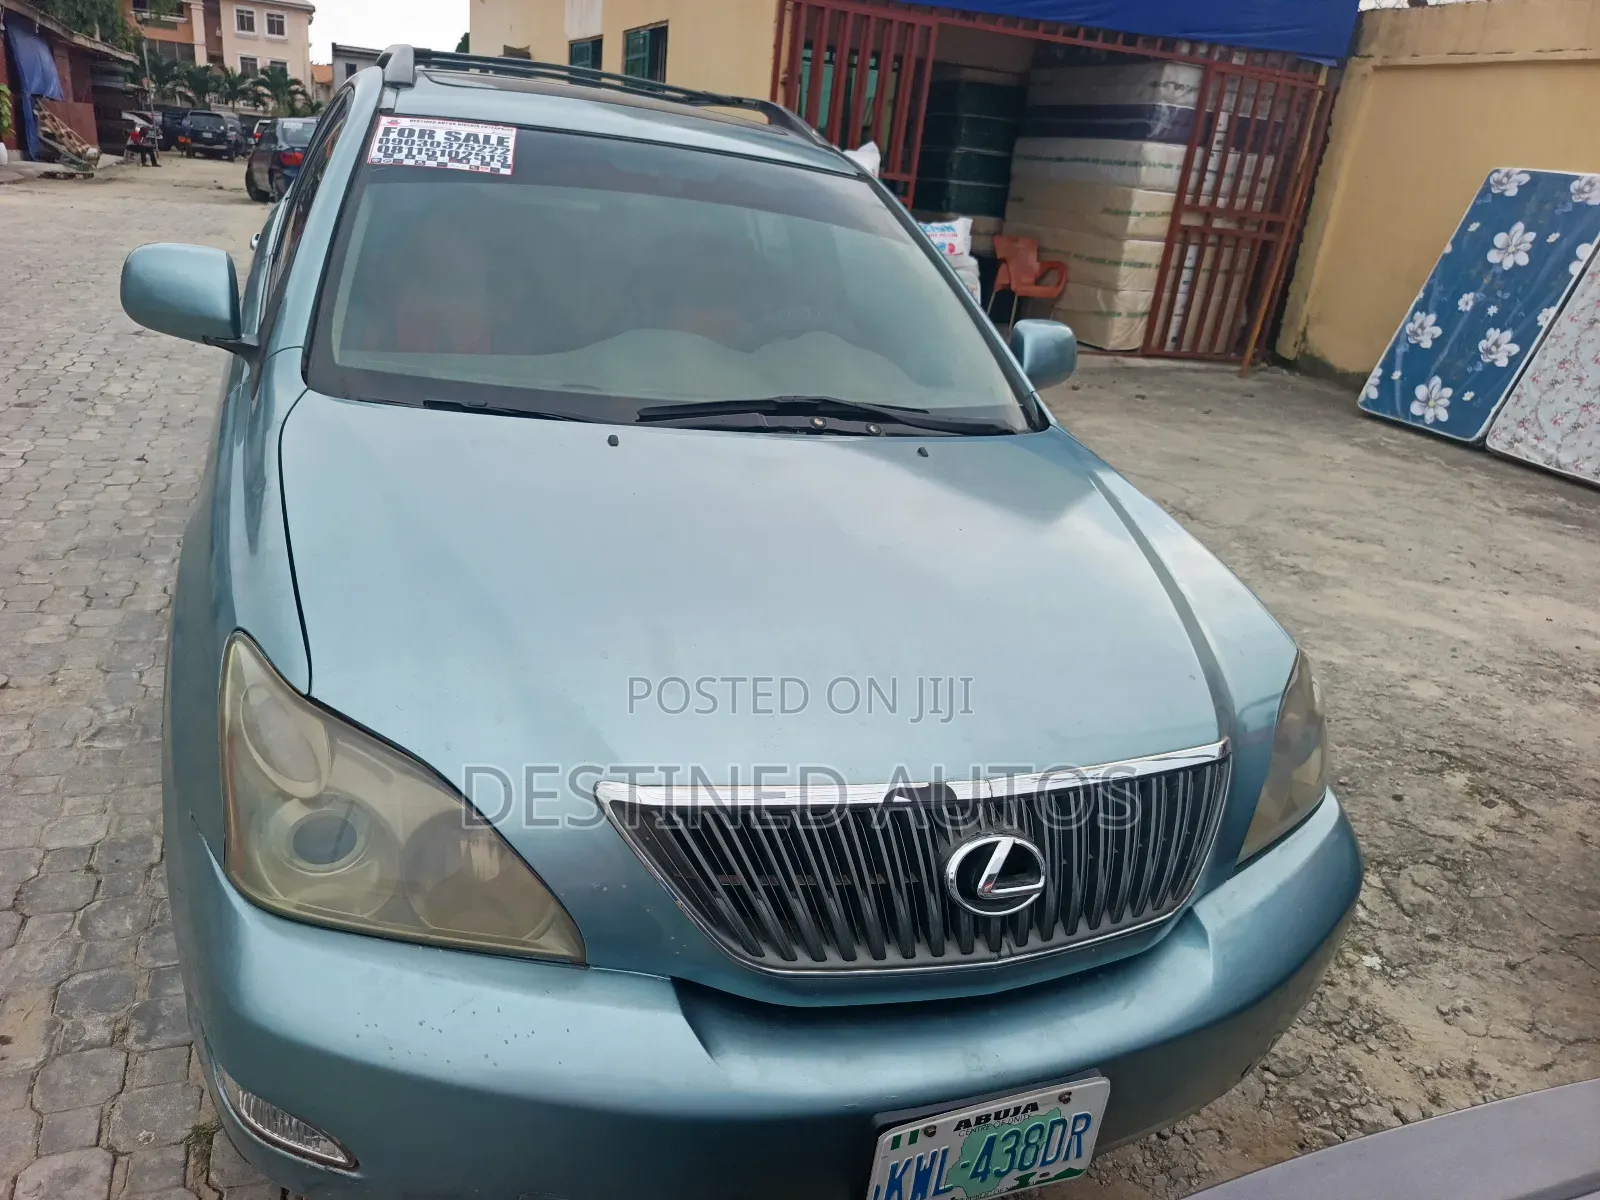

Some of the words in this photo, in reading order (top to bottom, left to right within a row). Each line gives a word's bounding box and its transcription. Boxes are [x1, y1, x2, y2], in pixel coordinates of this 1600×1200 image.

[378, 137, 511, 156] 09030375222
[381, 126, 437, 140] FOR
[443, 130, 511, 148] SALE
[952, 1101, 1040, 1133] ABUJA
[958, 1123, 992, 1138] CENTRE
